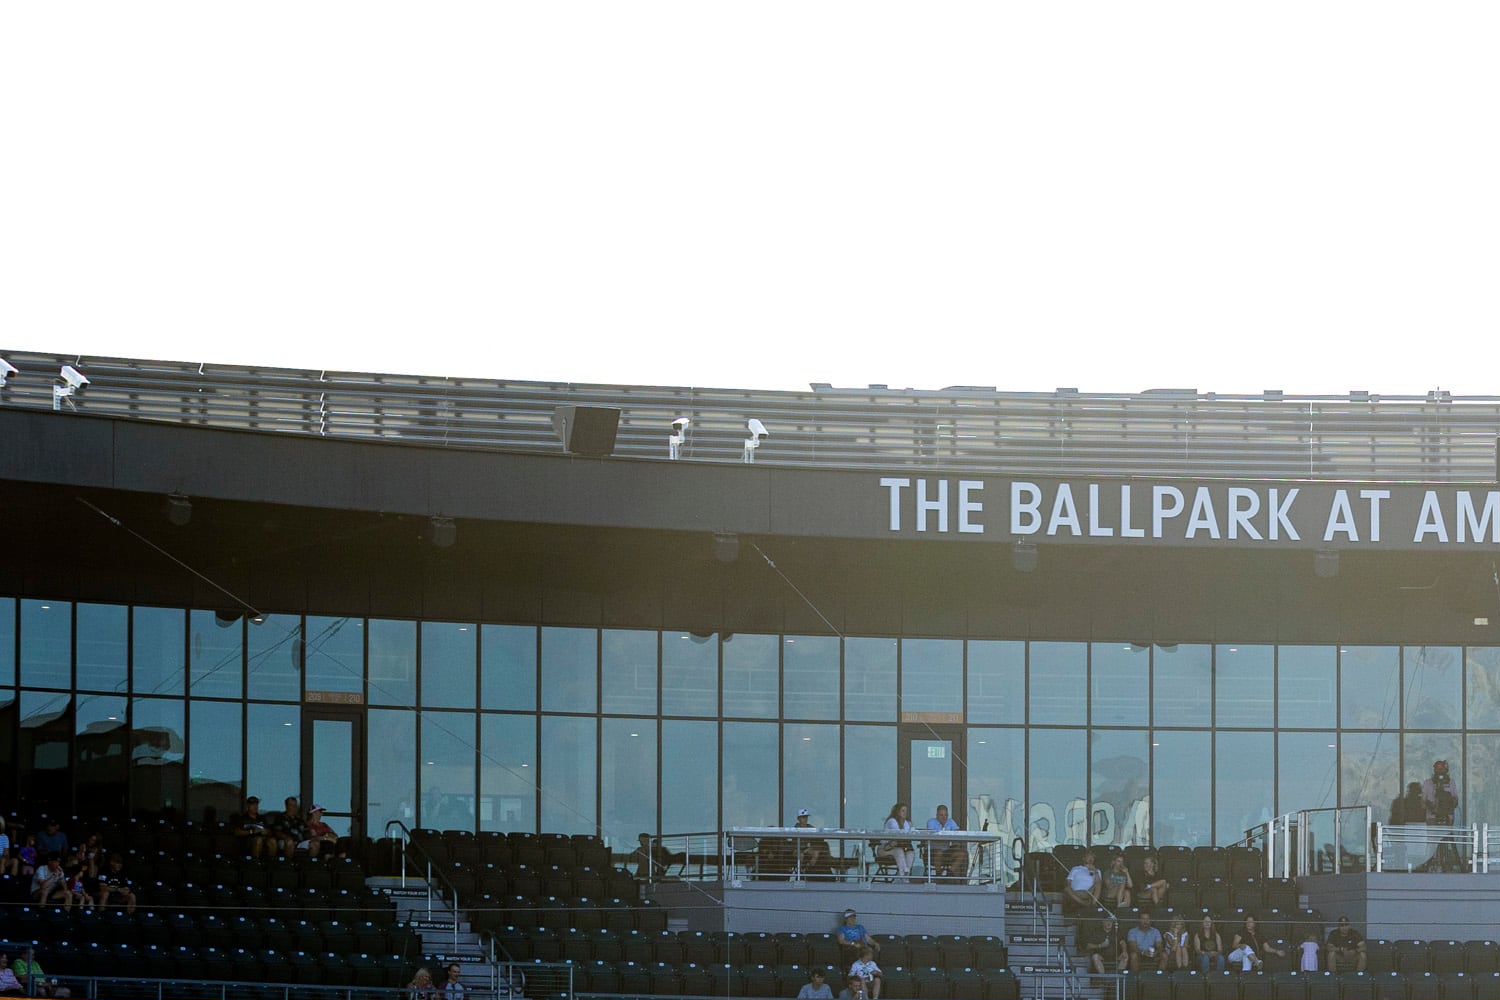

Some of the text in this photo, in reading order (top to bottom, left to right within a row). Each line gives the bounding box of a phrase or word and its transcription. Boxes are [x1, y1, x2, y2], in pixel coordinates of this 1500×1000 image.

[880, 477, 984, 533] THE
[1010, 481, 1301, 541] BALLPARK
[1322, 488, 1391, 542] AT
